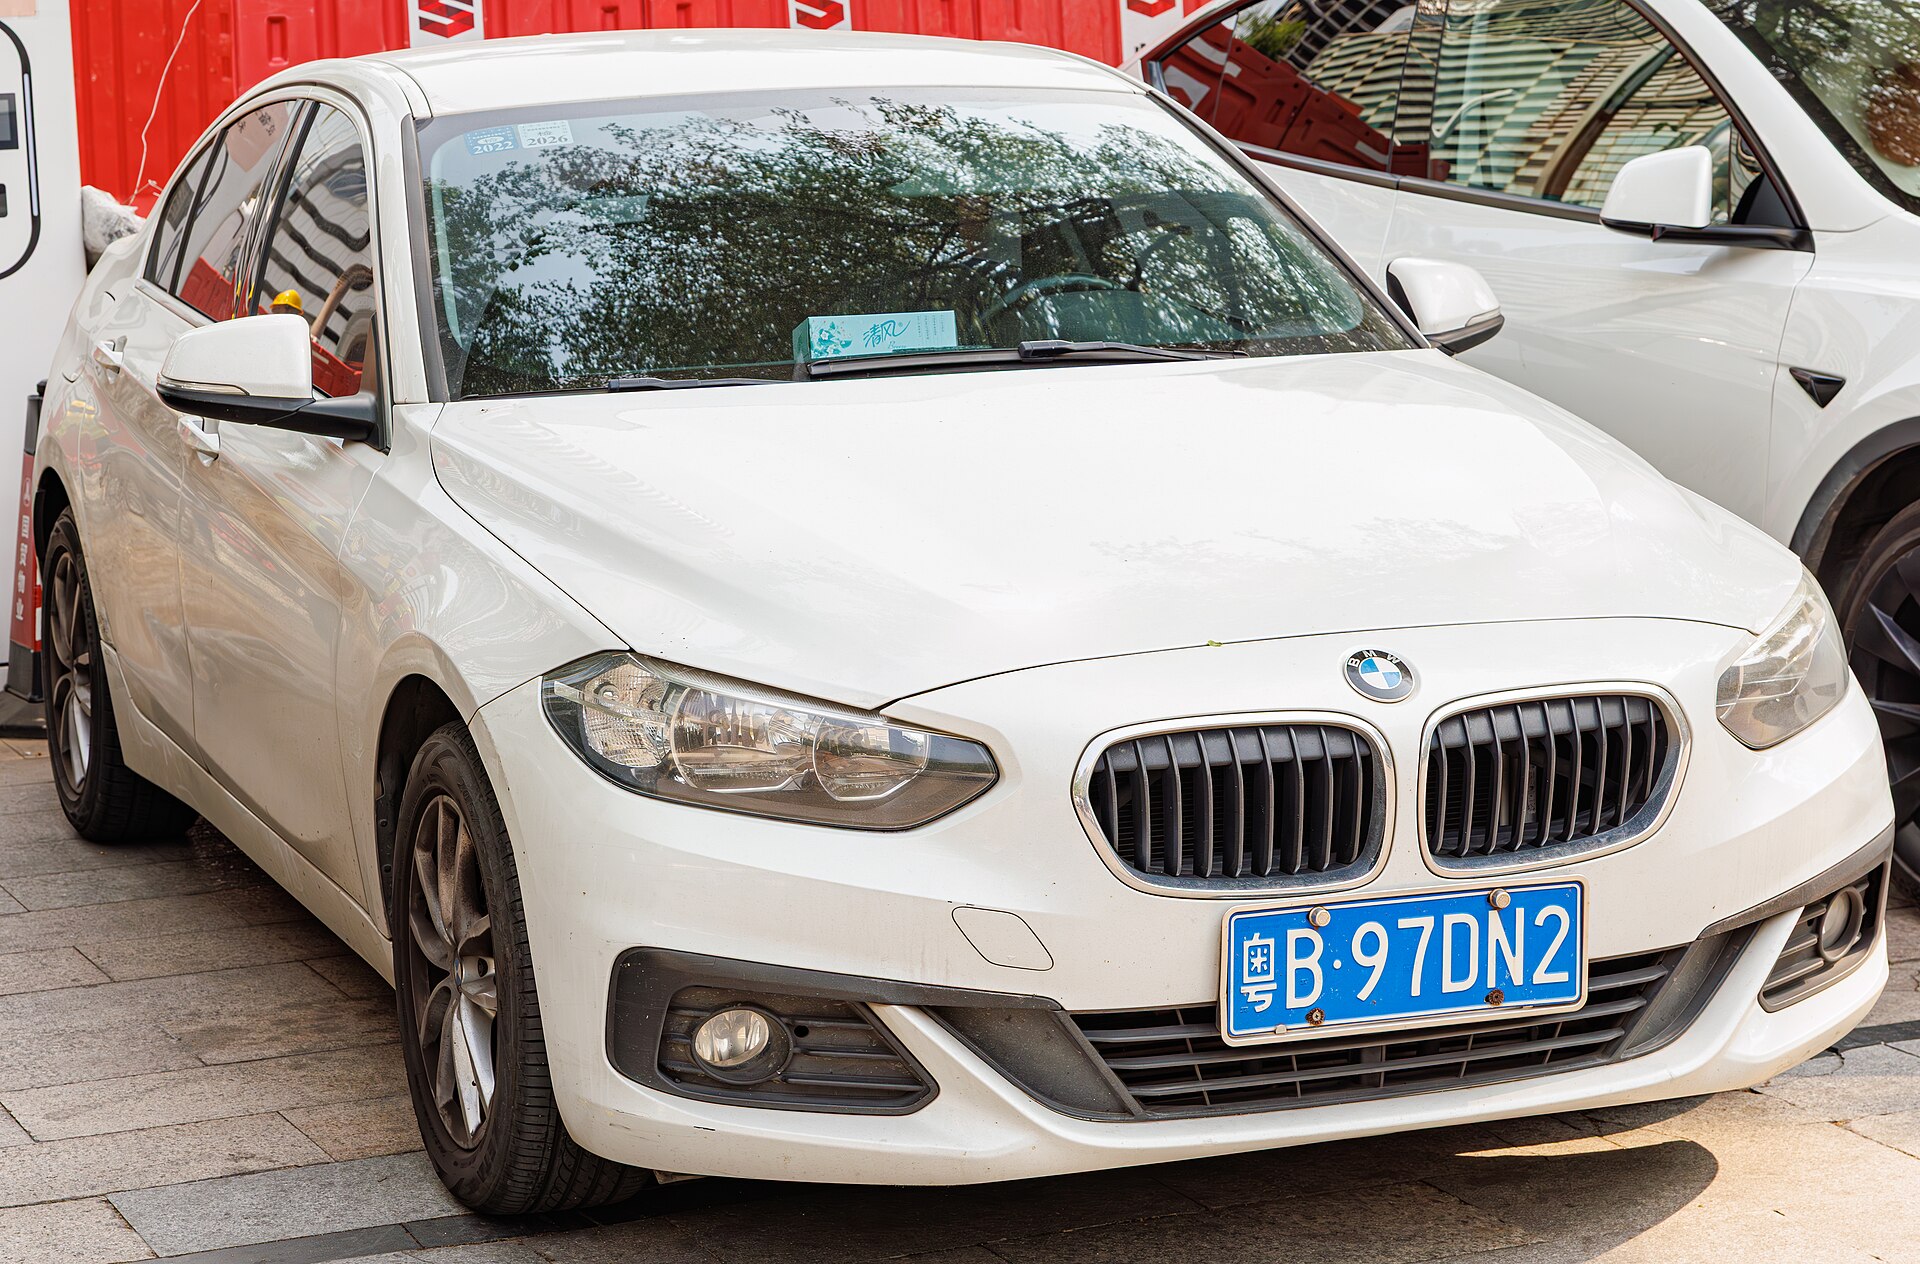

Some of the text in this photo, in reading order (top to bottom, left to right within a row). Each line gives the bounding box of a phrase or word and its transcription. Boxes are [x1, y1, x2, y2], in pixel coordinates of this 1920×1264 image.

[473, 140, 514, 155] 2022
[526, 135, 568, 147] 2026
[863, 319, 911, 348] 清风
[1347, 650, 1400, 668] BMW
